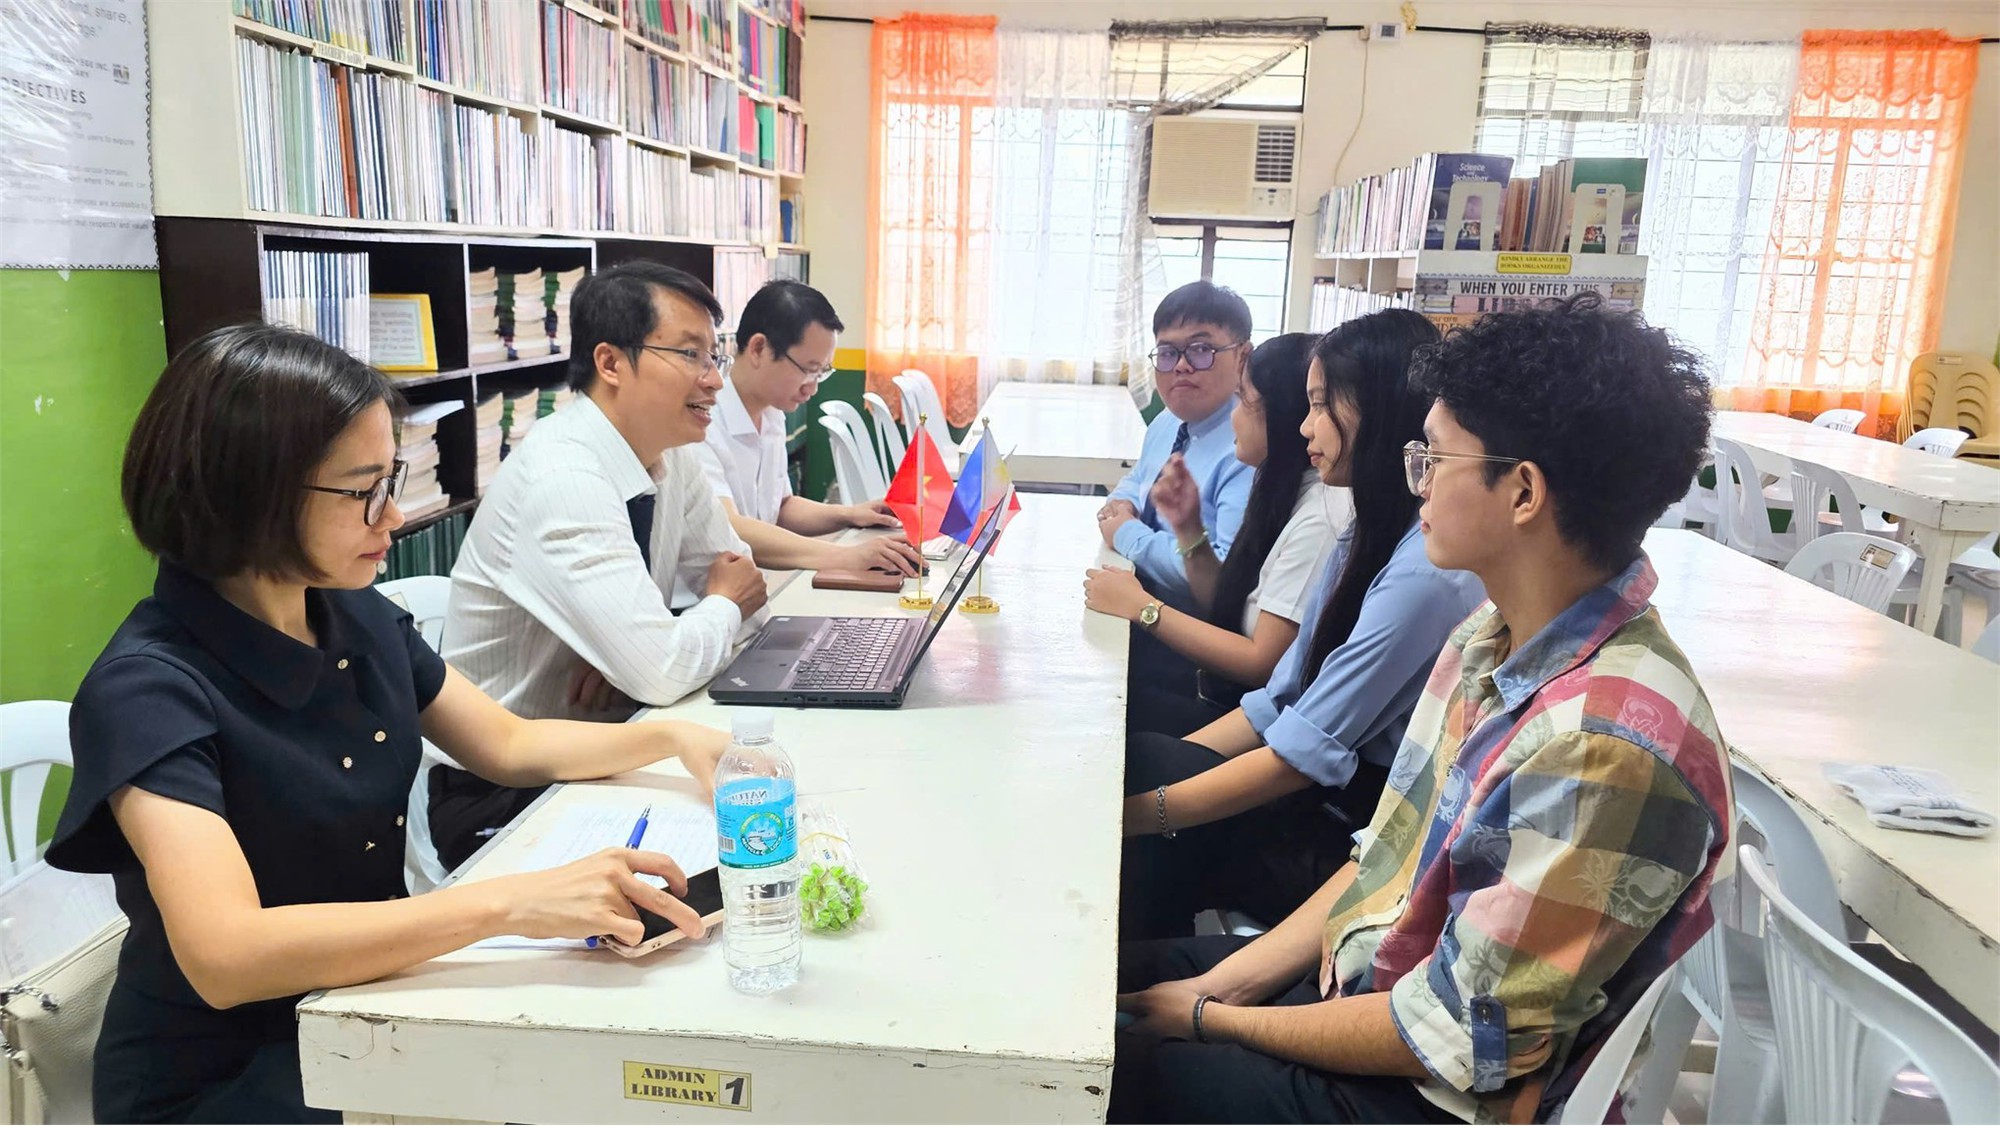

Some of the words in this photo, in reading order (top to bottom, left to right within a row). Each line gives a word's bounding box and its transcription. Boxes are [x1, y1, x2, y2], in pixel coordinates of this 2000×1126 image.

[0, 76, 87, 105] OBJECTIVES
[1460, 162, 1486, 172] Science
[1460, 281, 1497, 295] WHEN
[1501, 283, 1526, 296] YOU
[1529, 283, 1568, 297] ENTER
[641, 1067, 706, 1085] ADMIN
[631, 1083, 717, 1103] LIBRARY
[725, 1077, 745, 1105] 1
